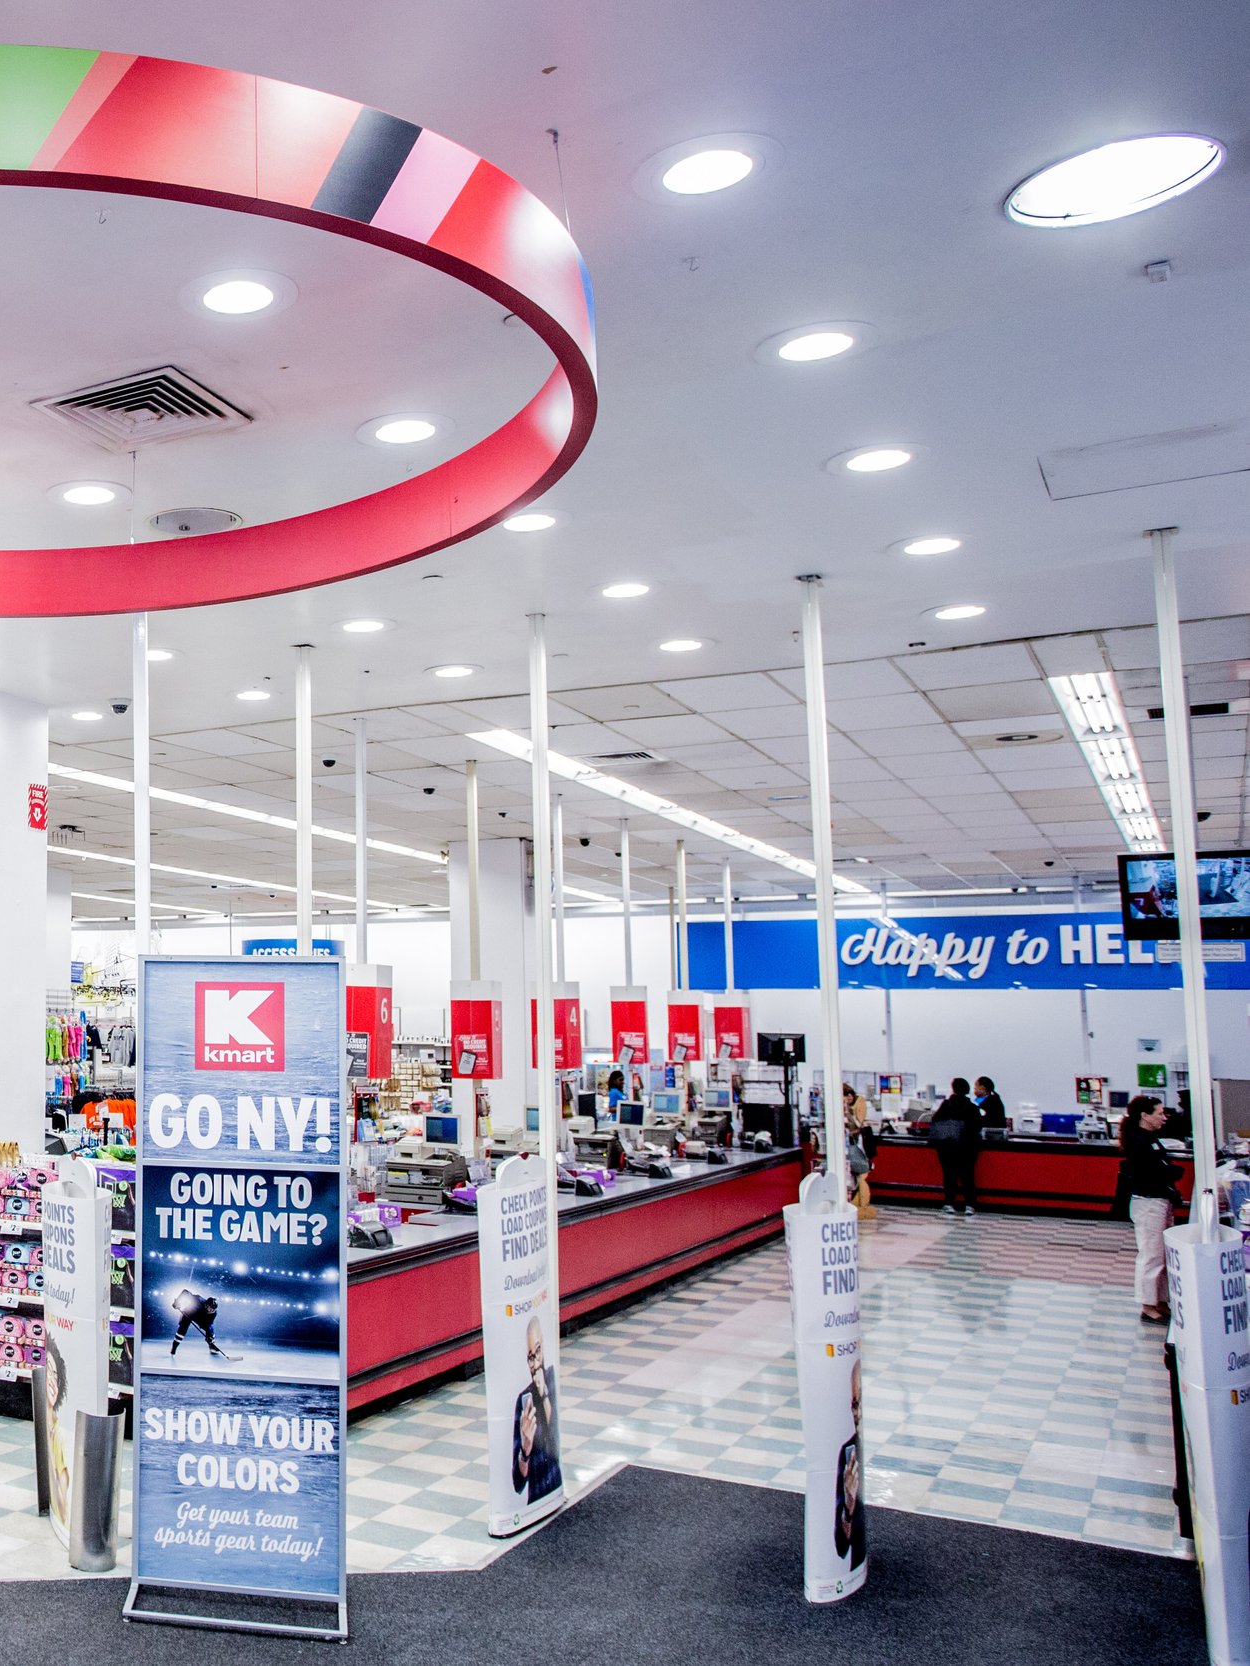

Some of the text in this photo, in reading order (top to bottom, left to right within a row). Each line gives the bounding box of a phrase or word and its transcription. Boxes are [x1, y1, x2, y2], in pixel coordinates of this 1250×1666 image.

[31, 790, 44, 798] FIRE
[841, 928, 996, 979] Happy
[1006, 928, 1049, 965] to
[204, 989, 275, 1046] K
[380, 998, 389, 1024] 6
[570, 1006, 578, 1027] 4
[204, 1046, 275, 1064] kmart
[148, 1092, 332, 1153] GO NY!
[170, 1172, 313, 1209] GOING TO
[501, 1185, 547, 1215] CHECK POINTS
[155, 1207, 328, 1246] THE GAME?
[501, 1206, 547, 1236] LOAD COUPONS
[821, 1221, 857, 1244] CHECK
[502, 1228, 548, 1262] FIND DEALS
[822, 1245, 851, 1267] LOAD
[50, 1284, 76, 1308] today!
[823, 1268, 855, 1296] FIND
[144, 1407, 335, 1453] SHOW YOUR
[177, 1453, 300, 1494] COLORS
[176, 1501, 299, 1530] Get your team
[154, 1527, 324, 1562] sports gear today!
